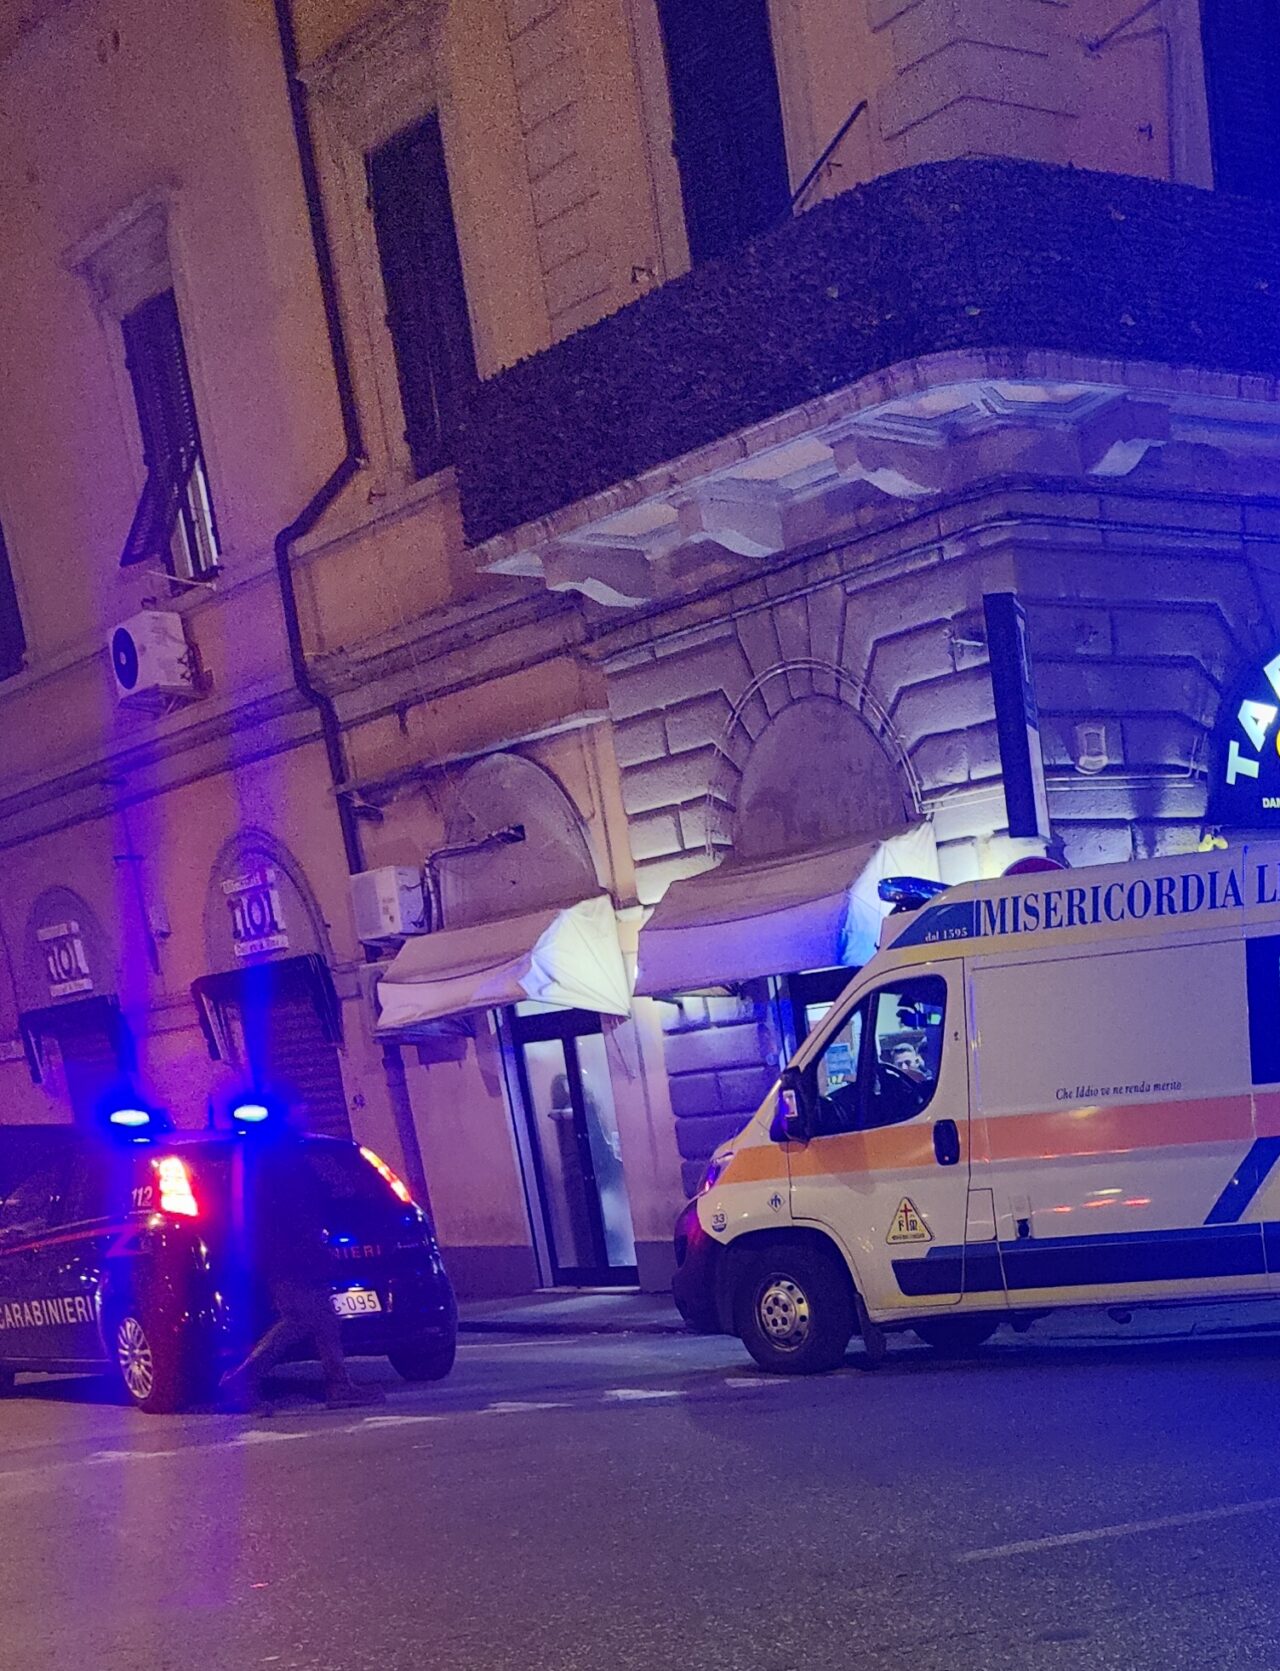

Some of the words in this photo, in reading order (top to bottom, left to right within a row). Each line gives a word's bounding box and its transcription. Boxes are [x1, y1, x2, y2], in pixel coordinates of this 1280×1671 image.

[982, 868, 1244, 937] MISERICORDIA
[925, 931, 939, 942] dal
[943, 927, 968, 940] 1595
[1056, 1088, 1073, 1101] Che
[1076, 1085, 1099, 1099] Iddio
[1113, 1086, 1123, 1095] ne
[1125, 1081, 1151, 1094] renda
[1153, 1080, 1182, 1092] merito
[131, 1185, 153, 1206] 112
[712, 1213, 725, 1224] 33
